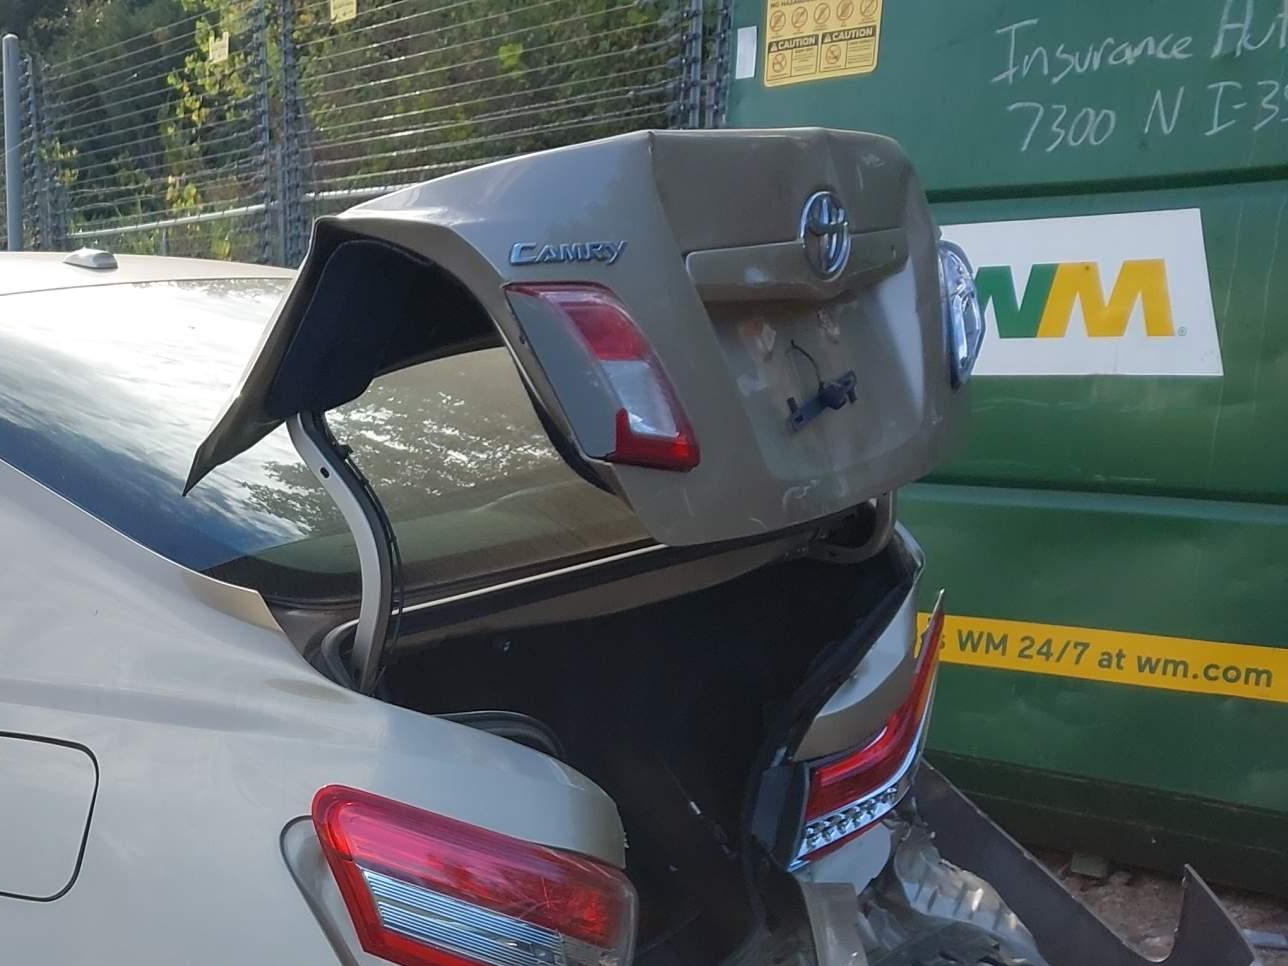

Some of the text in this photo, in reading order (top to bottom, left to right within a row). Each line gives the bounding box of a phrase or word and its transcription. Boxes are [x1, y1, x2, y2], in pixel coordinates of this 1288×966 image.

[778, 36, 816, 50] CAUTION
[832, 27, 873, 40] CAUTION
[991, 18, 1193, 84] Insurance
[1007, 101, 1116, 152] 7300
[1144, 86, 1185, 135] N
[510, 240, 627, 265] CAMRY
[957, 629, 1008, 656] WM
[1017, 635, 1090, 665] 24/7
[1098, 649, 1126, 670] at
[1137, 655, 1272, 688] wm.com
